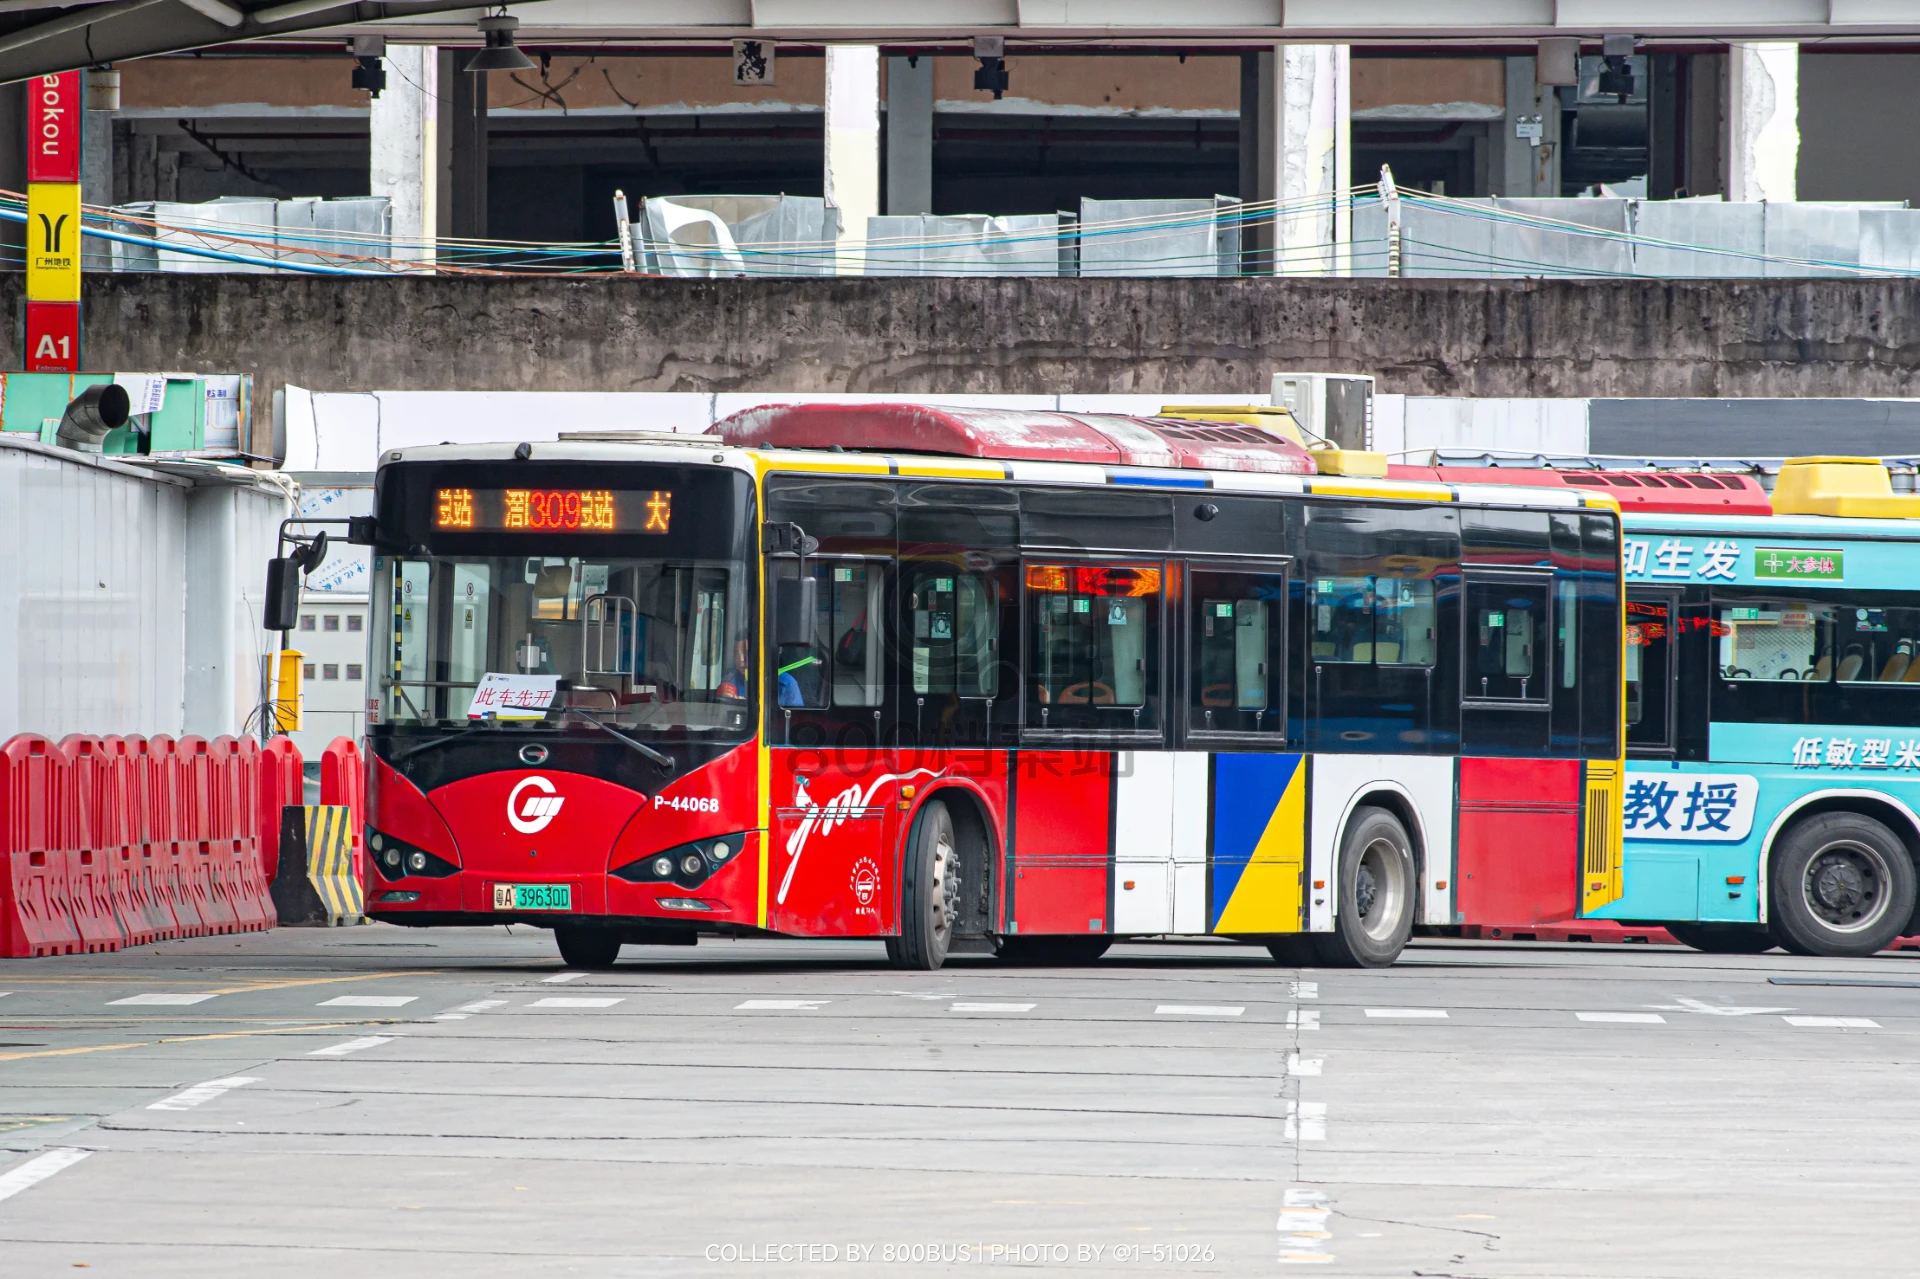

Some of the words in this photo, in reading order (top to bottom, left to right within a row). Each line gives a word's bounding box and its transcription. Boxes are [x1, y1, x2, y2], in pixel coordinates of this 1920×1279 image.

[36, 257, 71, 266] 广州地铁
[35, 334, 70, 359] A1
[529, 490, 581, 528] 309
[1623, 539, 1741, 581] 和生发
[1786, 556, 1835, 574] 大参林
[475, 687, 553, 707] 此车先开
[1792, 736, 1920, 770] 低敏型米
[654, 795, 719, 813] P-44068
[1622, 779, 1739, 832] 教授
